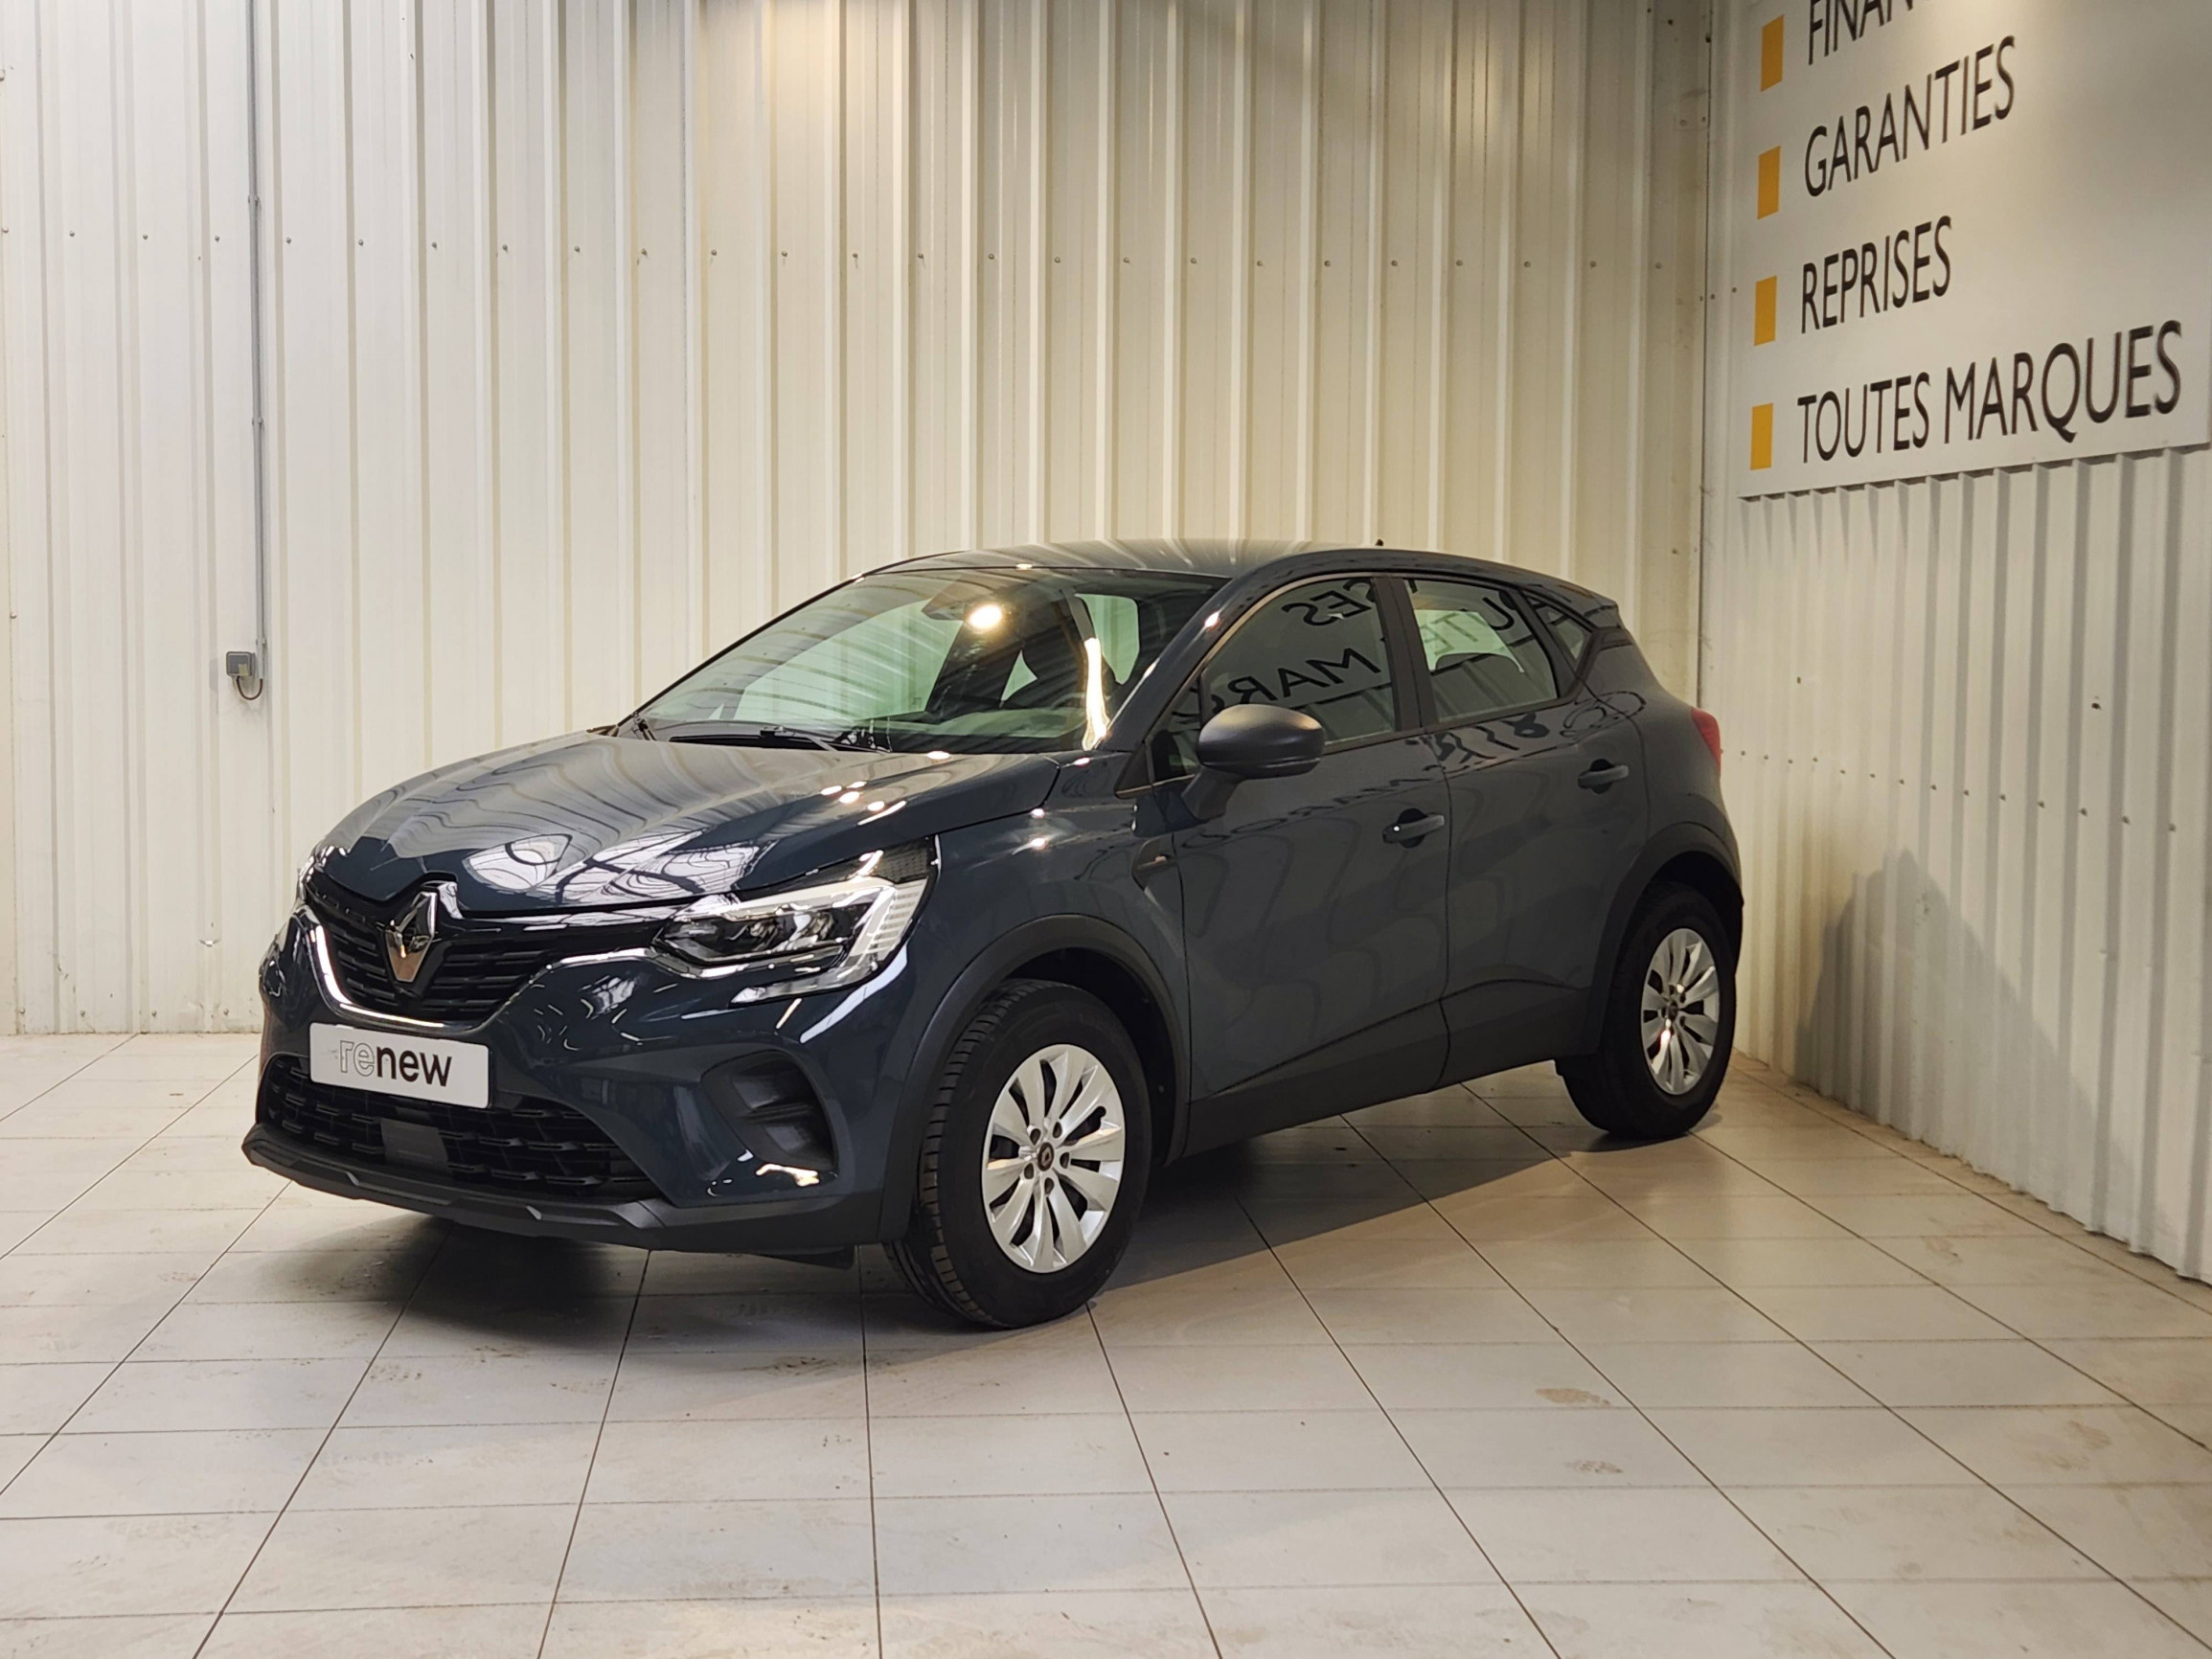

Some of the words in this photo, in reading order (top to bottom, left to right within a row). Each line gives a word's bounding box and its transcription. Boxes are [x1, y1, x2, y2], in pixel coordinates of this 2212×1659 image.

[1804, 35, 2015, 197] GARANTIES
[1801, 216, 1951, 334] REPRISES
[1796, 373, 1930, 464] TOUTES
[1944, 320, 2181, 443] MARQUES
[339, 1039, 453, 1088] renew
